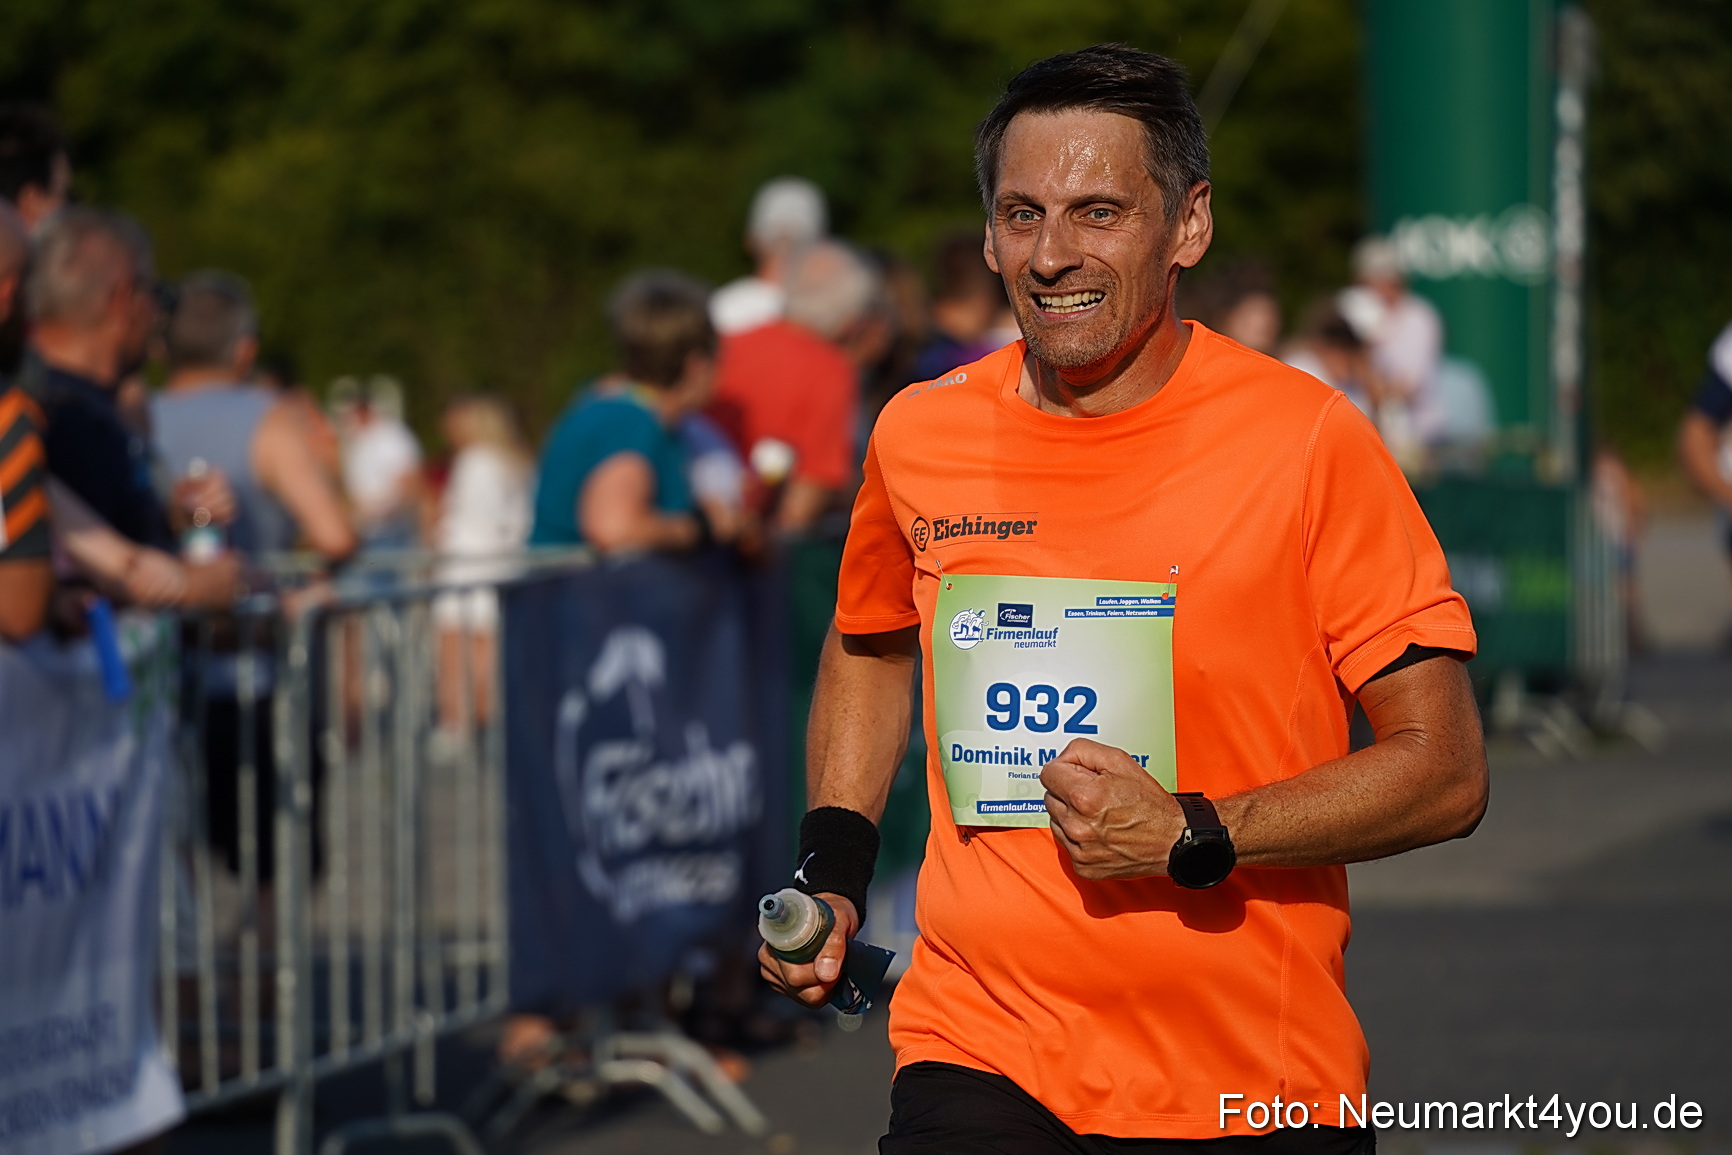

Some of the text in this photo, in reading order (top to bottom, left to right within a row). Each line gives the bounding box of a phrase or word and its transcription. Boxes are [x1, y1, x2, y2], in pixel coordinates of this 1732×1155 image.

[926, 372, 968, 391] JAKO
[932, 516, 1038, 541] Eichinger
[986, 627, 1059, 640] Firmenlauf
[1014, 639, 1057, 648] neumarkt
[986, 682, 1099, 735] 932
[951, 743, 1033, 767] Dominik
[1007, 771, 1031, 779] Florian
